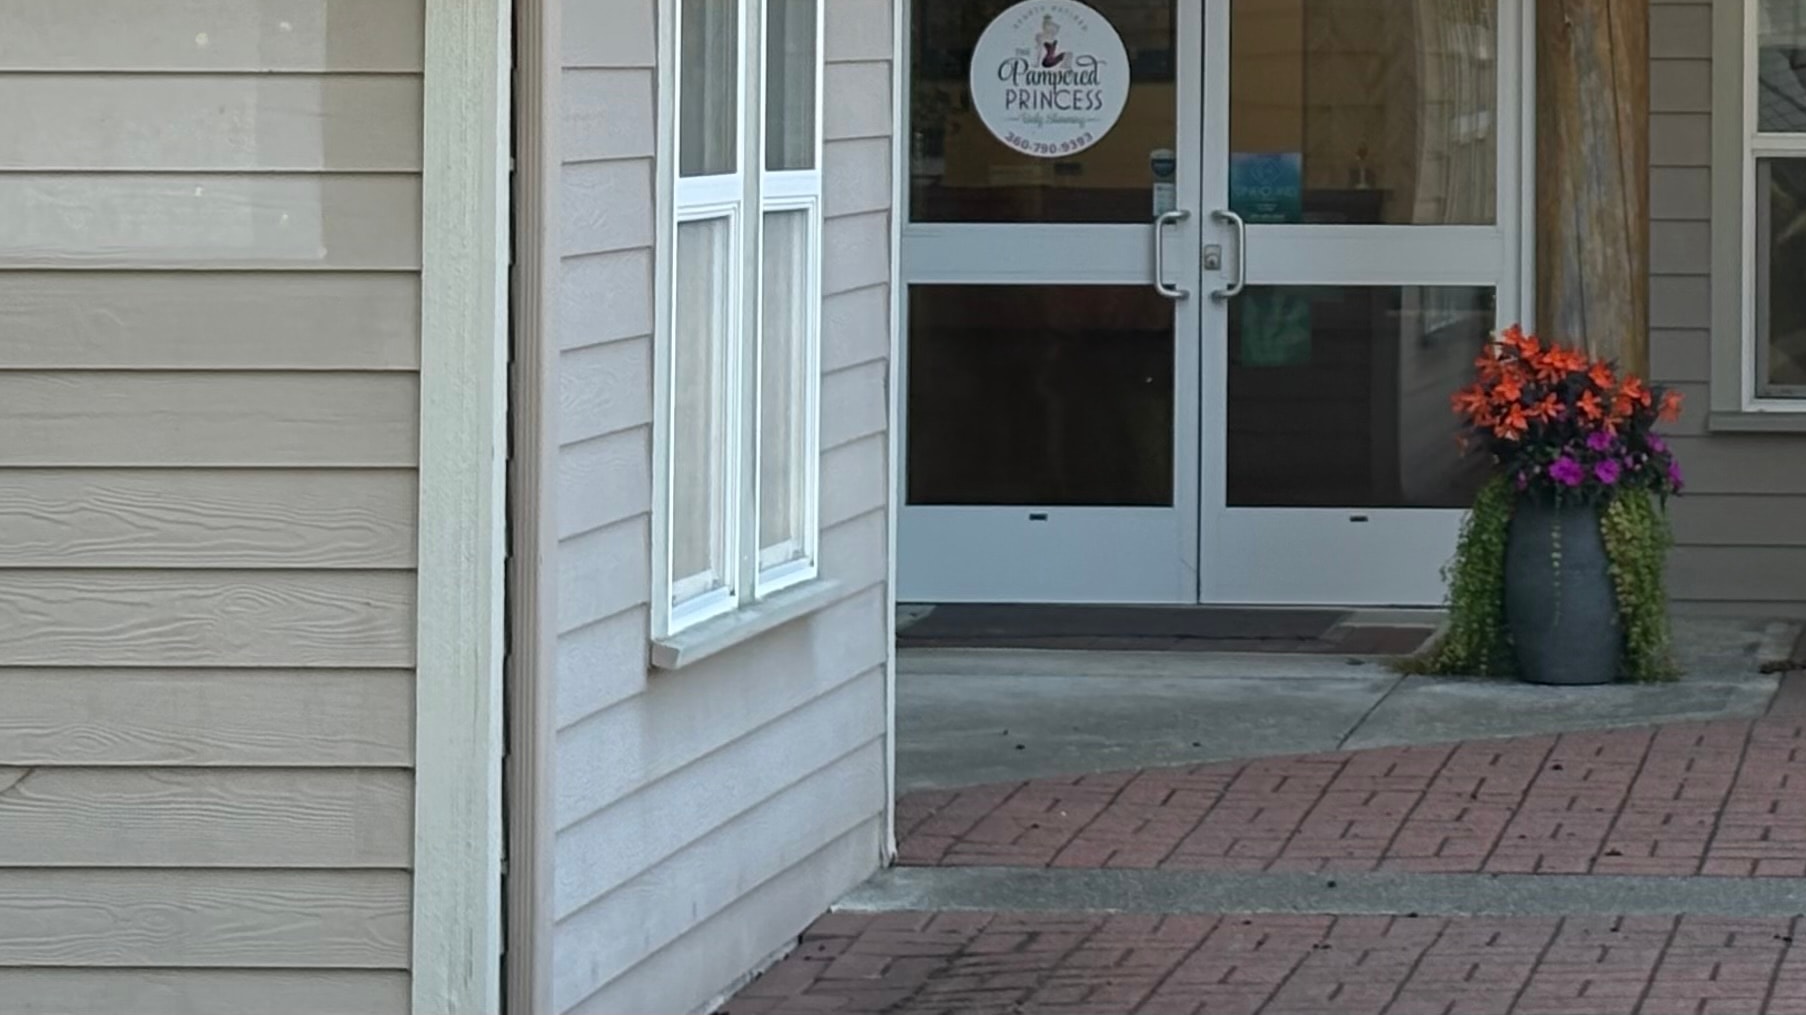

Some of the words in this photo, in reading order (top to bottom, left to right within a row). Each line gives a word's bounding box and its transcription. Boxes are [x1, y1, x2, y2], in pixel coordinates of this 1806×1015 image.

[997, 54, 1107, 95] Pampered
[1005, 88, 1103, 111] PRINCESS
[1004, 131, 1093, 154] 360-790-9393
